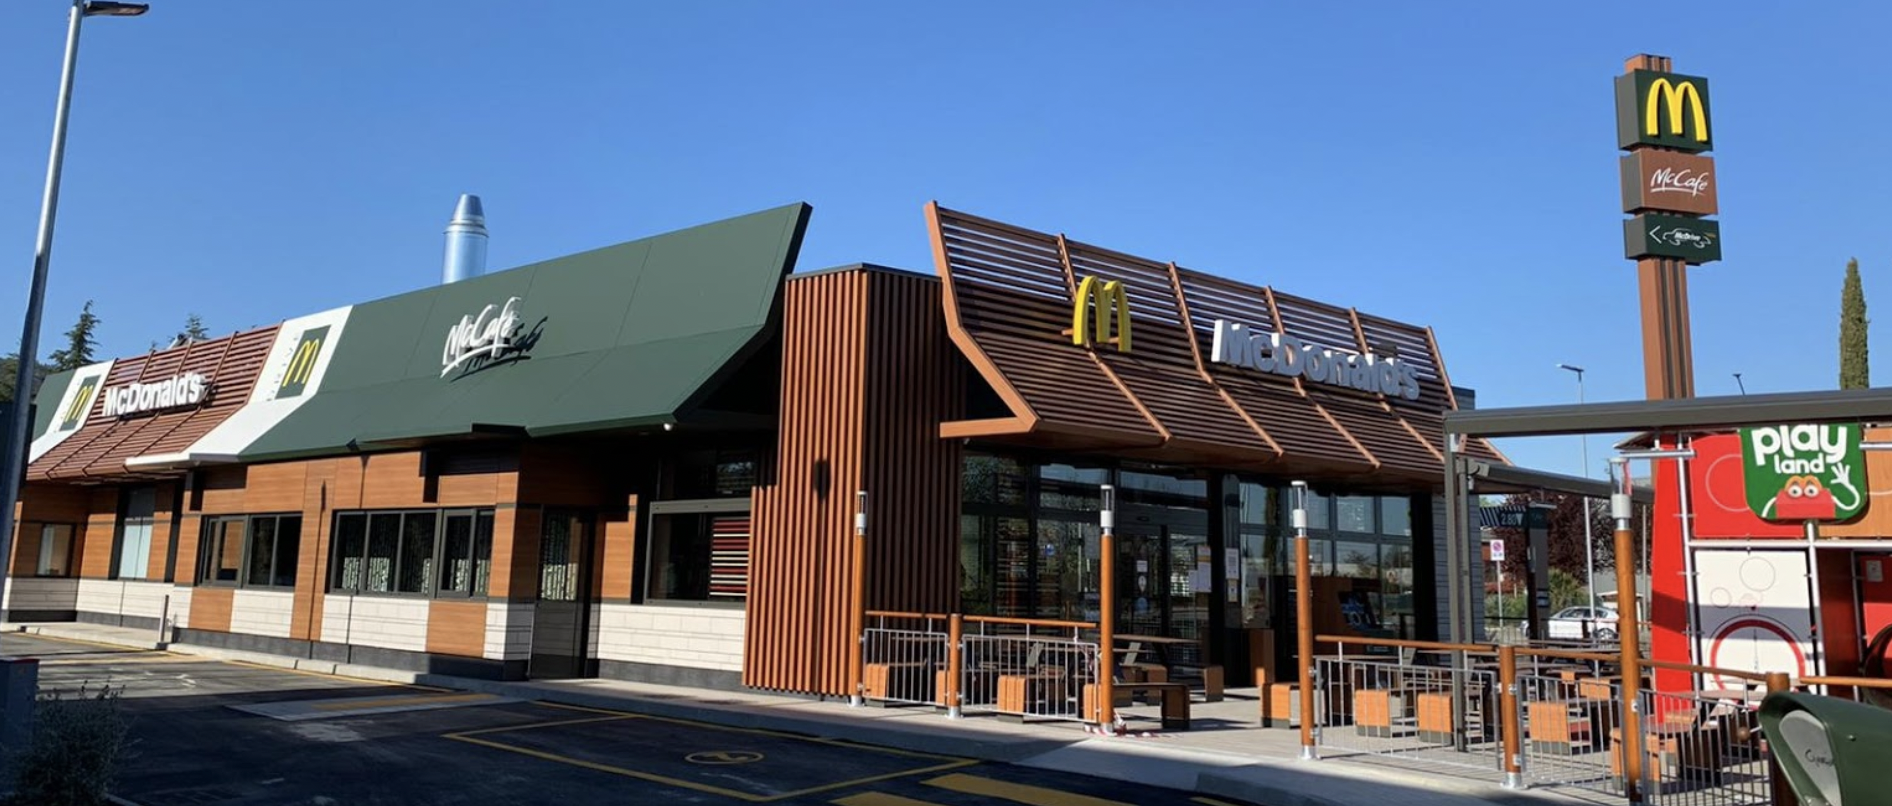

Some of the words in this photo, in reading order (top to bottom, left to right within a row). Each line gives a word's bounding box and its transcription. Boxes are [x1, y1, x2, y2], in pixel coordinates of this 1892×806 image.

[1646, 77, 1708, 142] M
[1211, 319, 1420, 401] McDonald's
[102, 371, 207, 417] McDonald's
[1751, 423, 1847, 466] play
[1774, 453, 1825, 474] land
